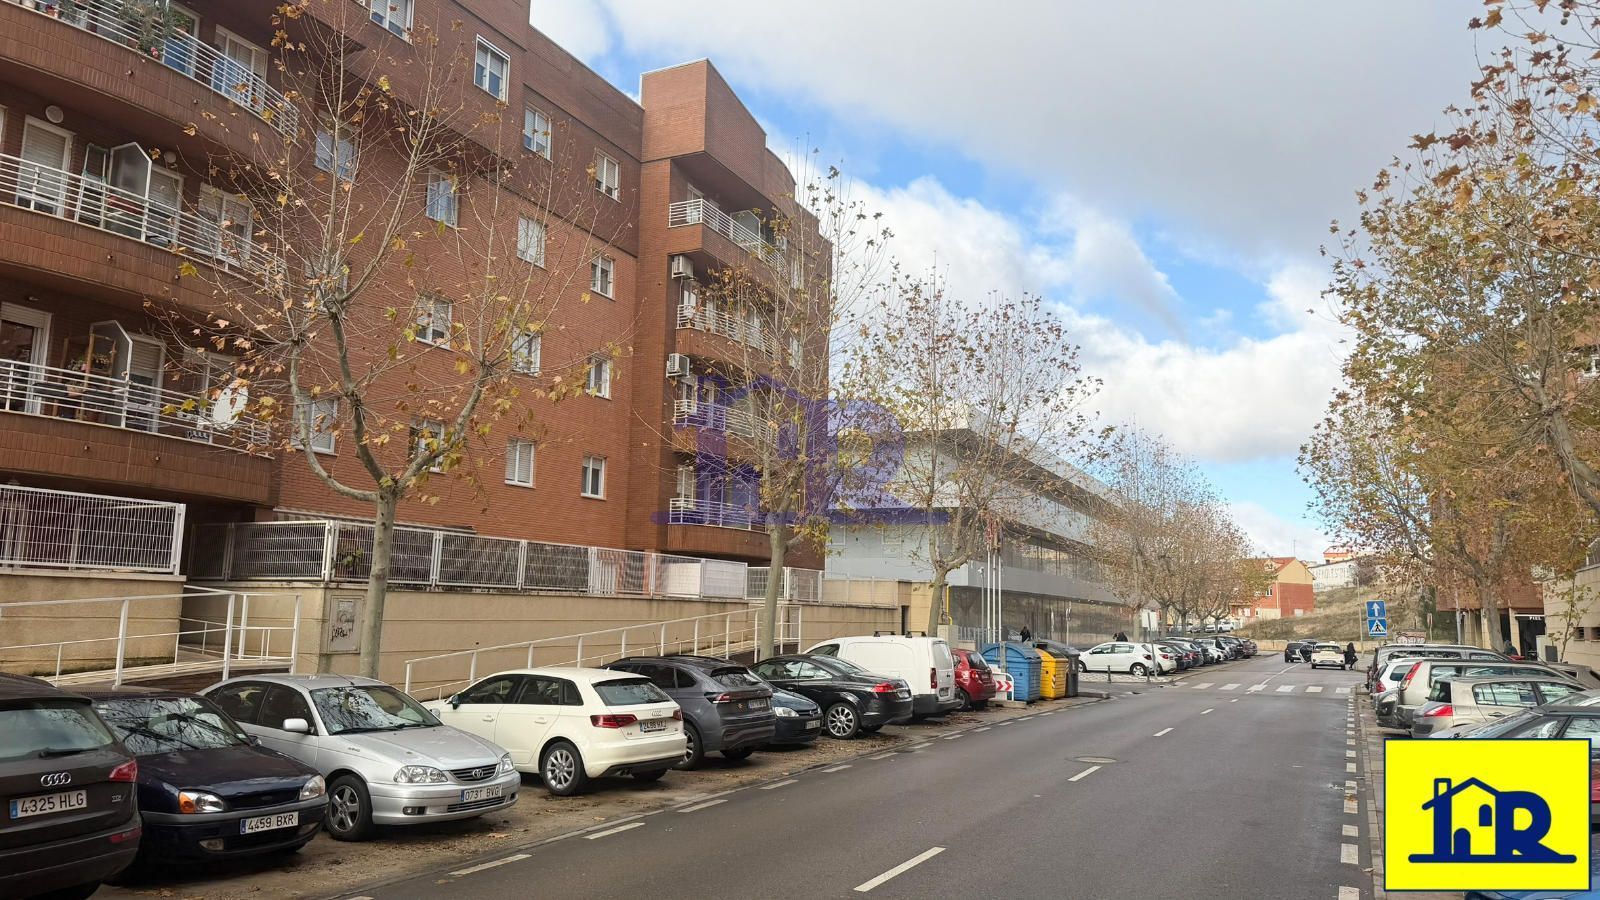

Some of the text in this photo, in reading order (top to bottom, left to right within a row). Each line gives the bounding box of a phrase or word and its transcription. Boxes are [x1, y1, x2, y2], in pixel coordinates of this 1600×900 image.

[21, 792, 84, 814] 4325 HLG
[248, 814, 294, 832] 4459 BXR
